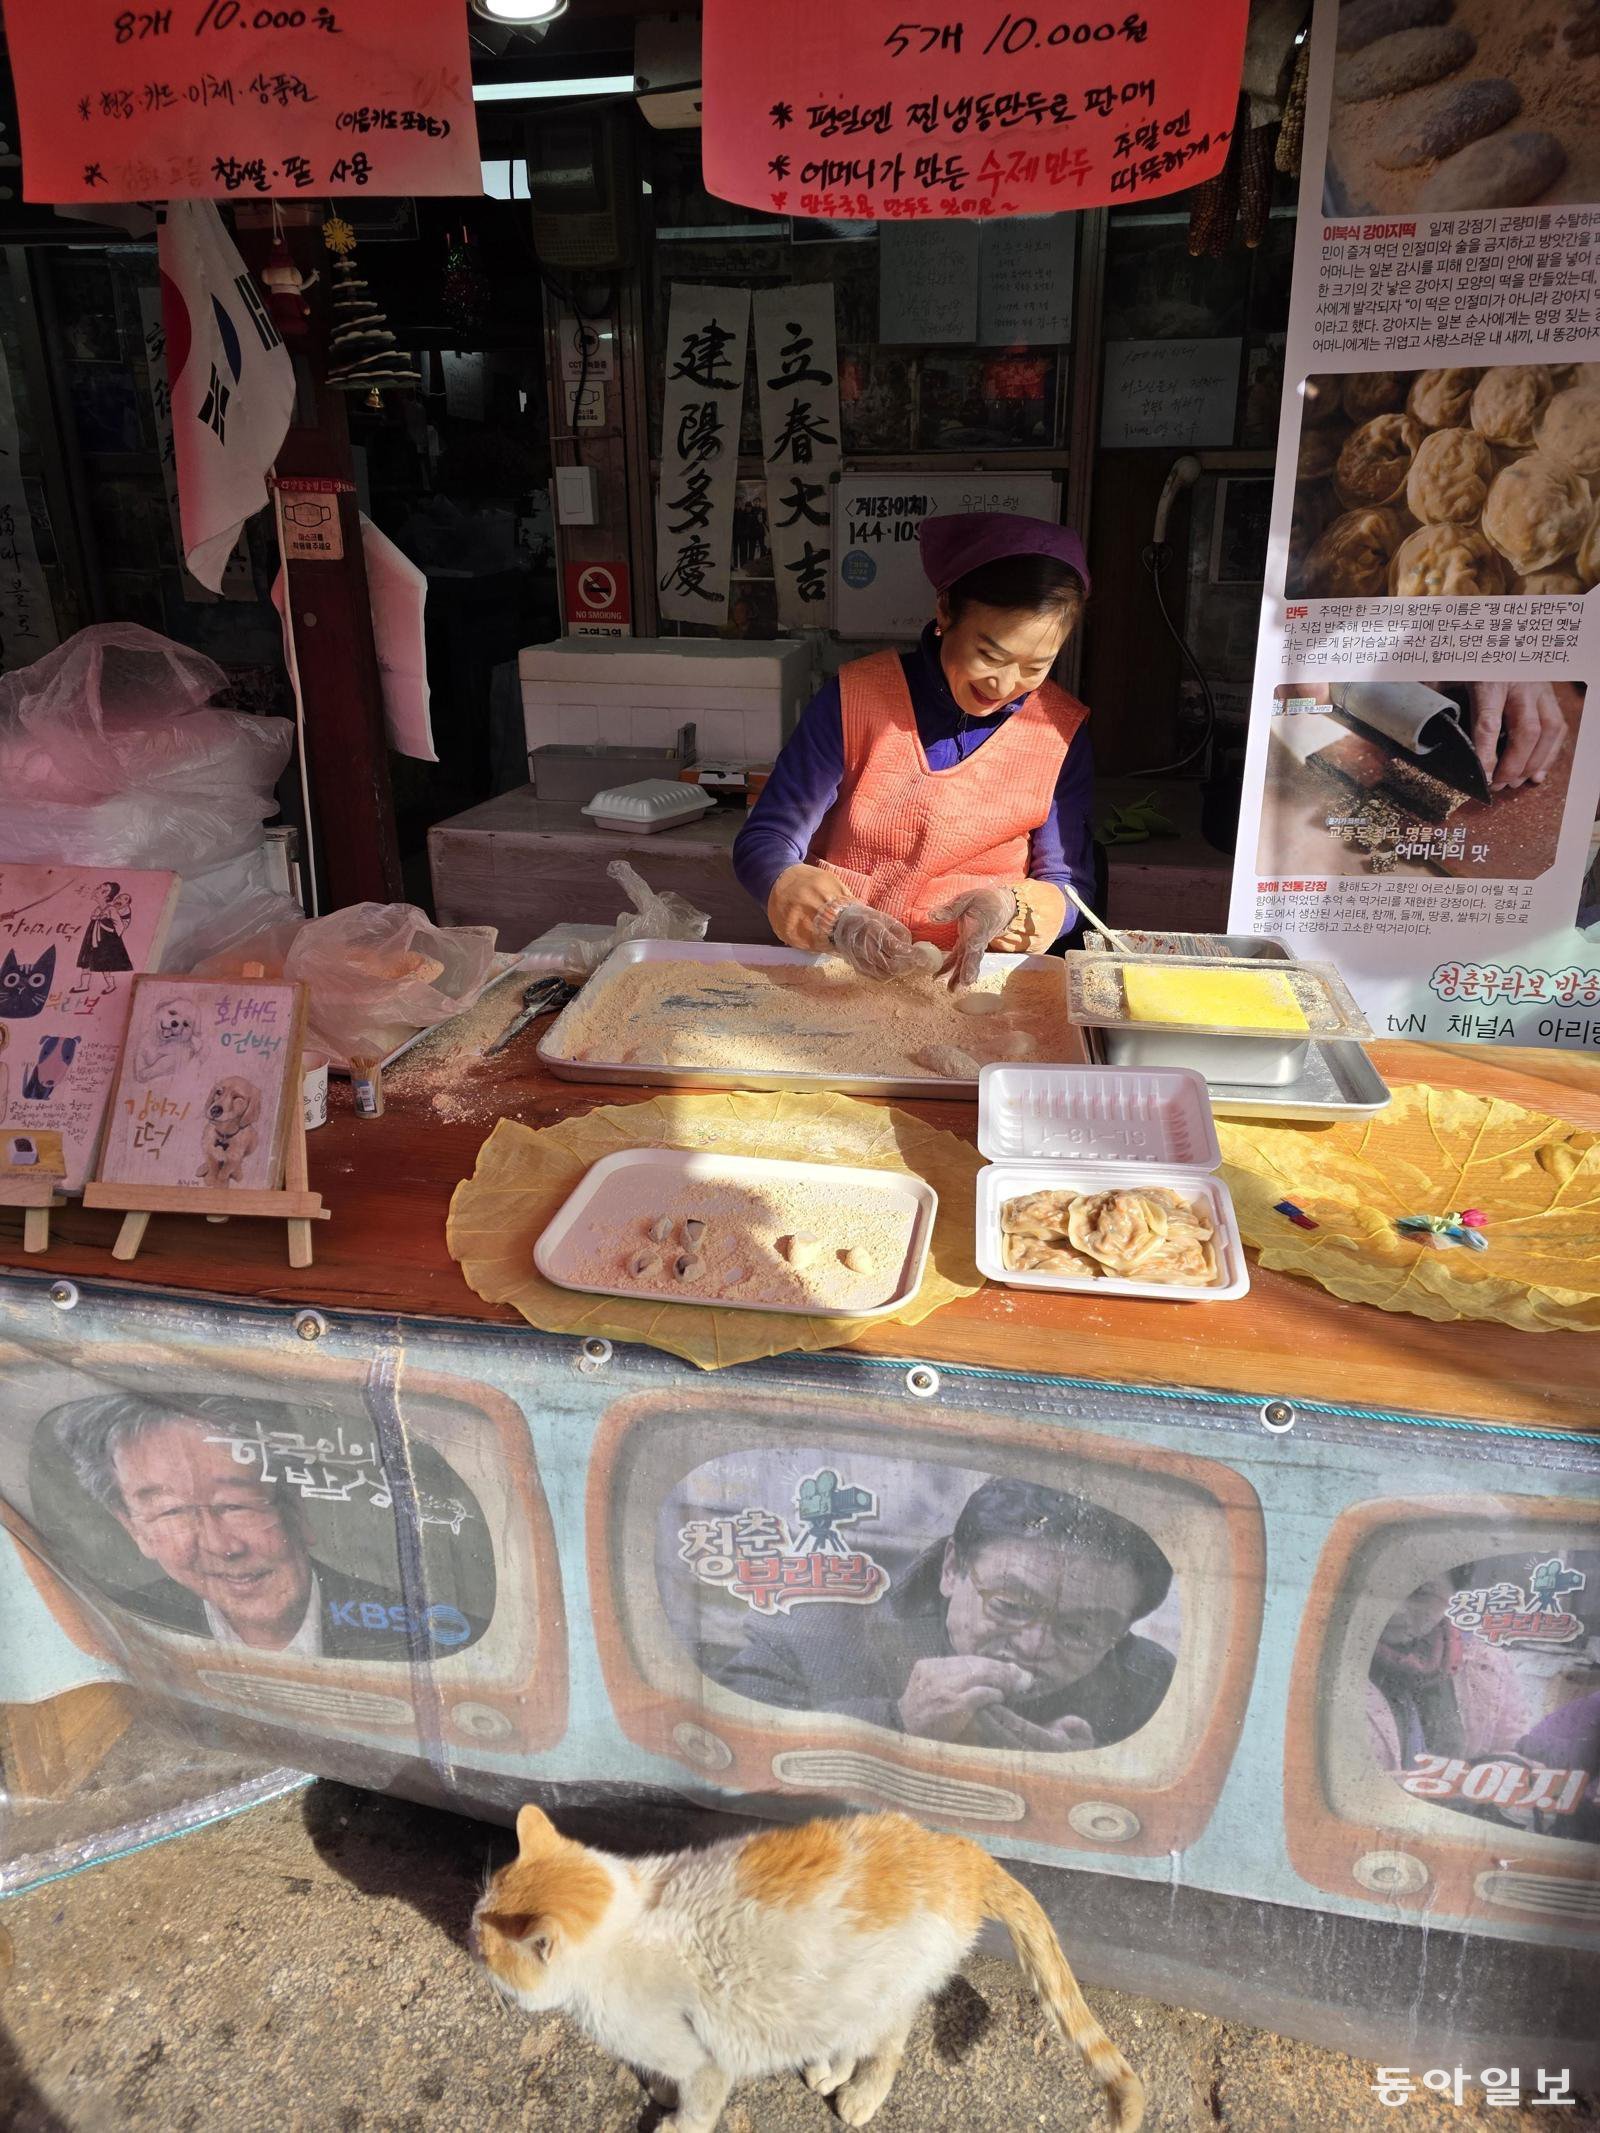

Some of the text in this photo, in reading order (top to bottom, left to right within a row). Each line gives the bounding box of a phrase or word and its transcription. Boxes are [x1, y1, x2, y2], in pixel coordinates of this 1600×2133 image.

[884, 22, 963, 57] 5개
[1085, 79, 1155, 116] 판매
[800, 152, 906, 192] 어머니가
[913, 152, 969, 191] 만든
[1323, 224, 1360, 241] 이북식
[1363, 223, 1417, 240] 강아지떡
[767, 322, 837, 603] 立春大吉
[576, 611, 622, 620] NO SMOKING
[1286, 606, 1308, 619] 만두
[1395, 843, 1490, 863] 어머니의 맛
[1257, 881, 1280, 893] 황해
[1282, 881, 1328, 893] 전통강정
[1438, 966, 1546, 999] 청춘부라보
[214, 995, 277, 1026] 황해도
[1387, 1014, 1426, 1033] tvN
[1449, 1012, 1515, 1038] 채널A
[126, 1090, 190, 1120] 강아지
[133, 1121, 172, 1159] 떡
[682, 1510, 783, 1578] 청춘
[734, 1552, 880, 1607] 부라보
[1450, 1586, 1521, 1627] 청춘
[1480, 1611, 1582, 1642] 부라보
